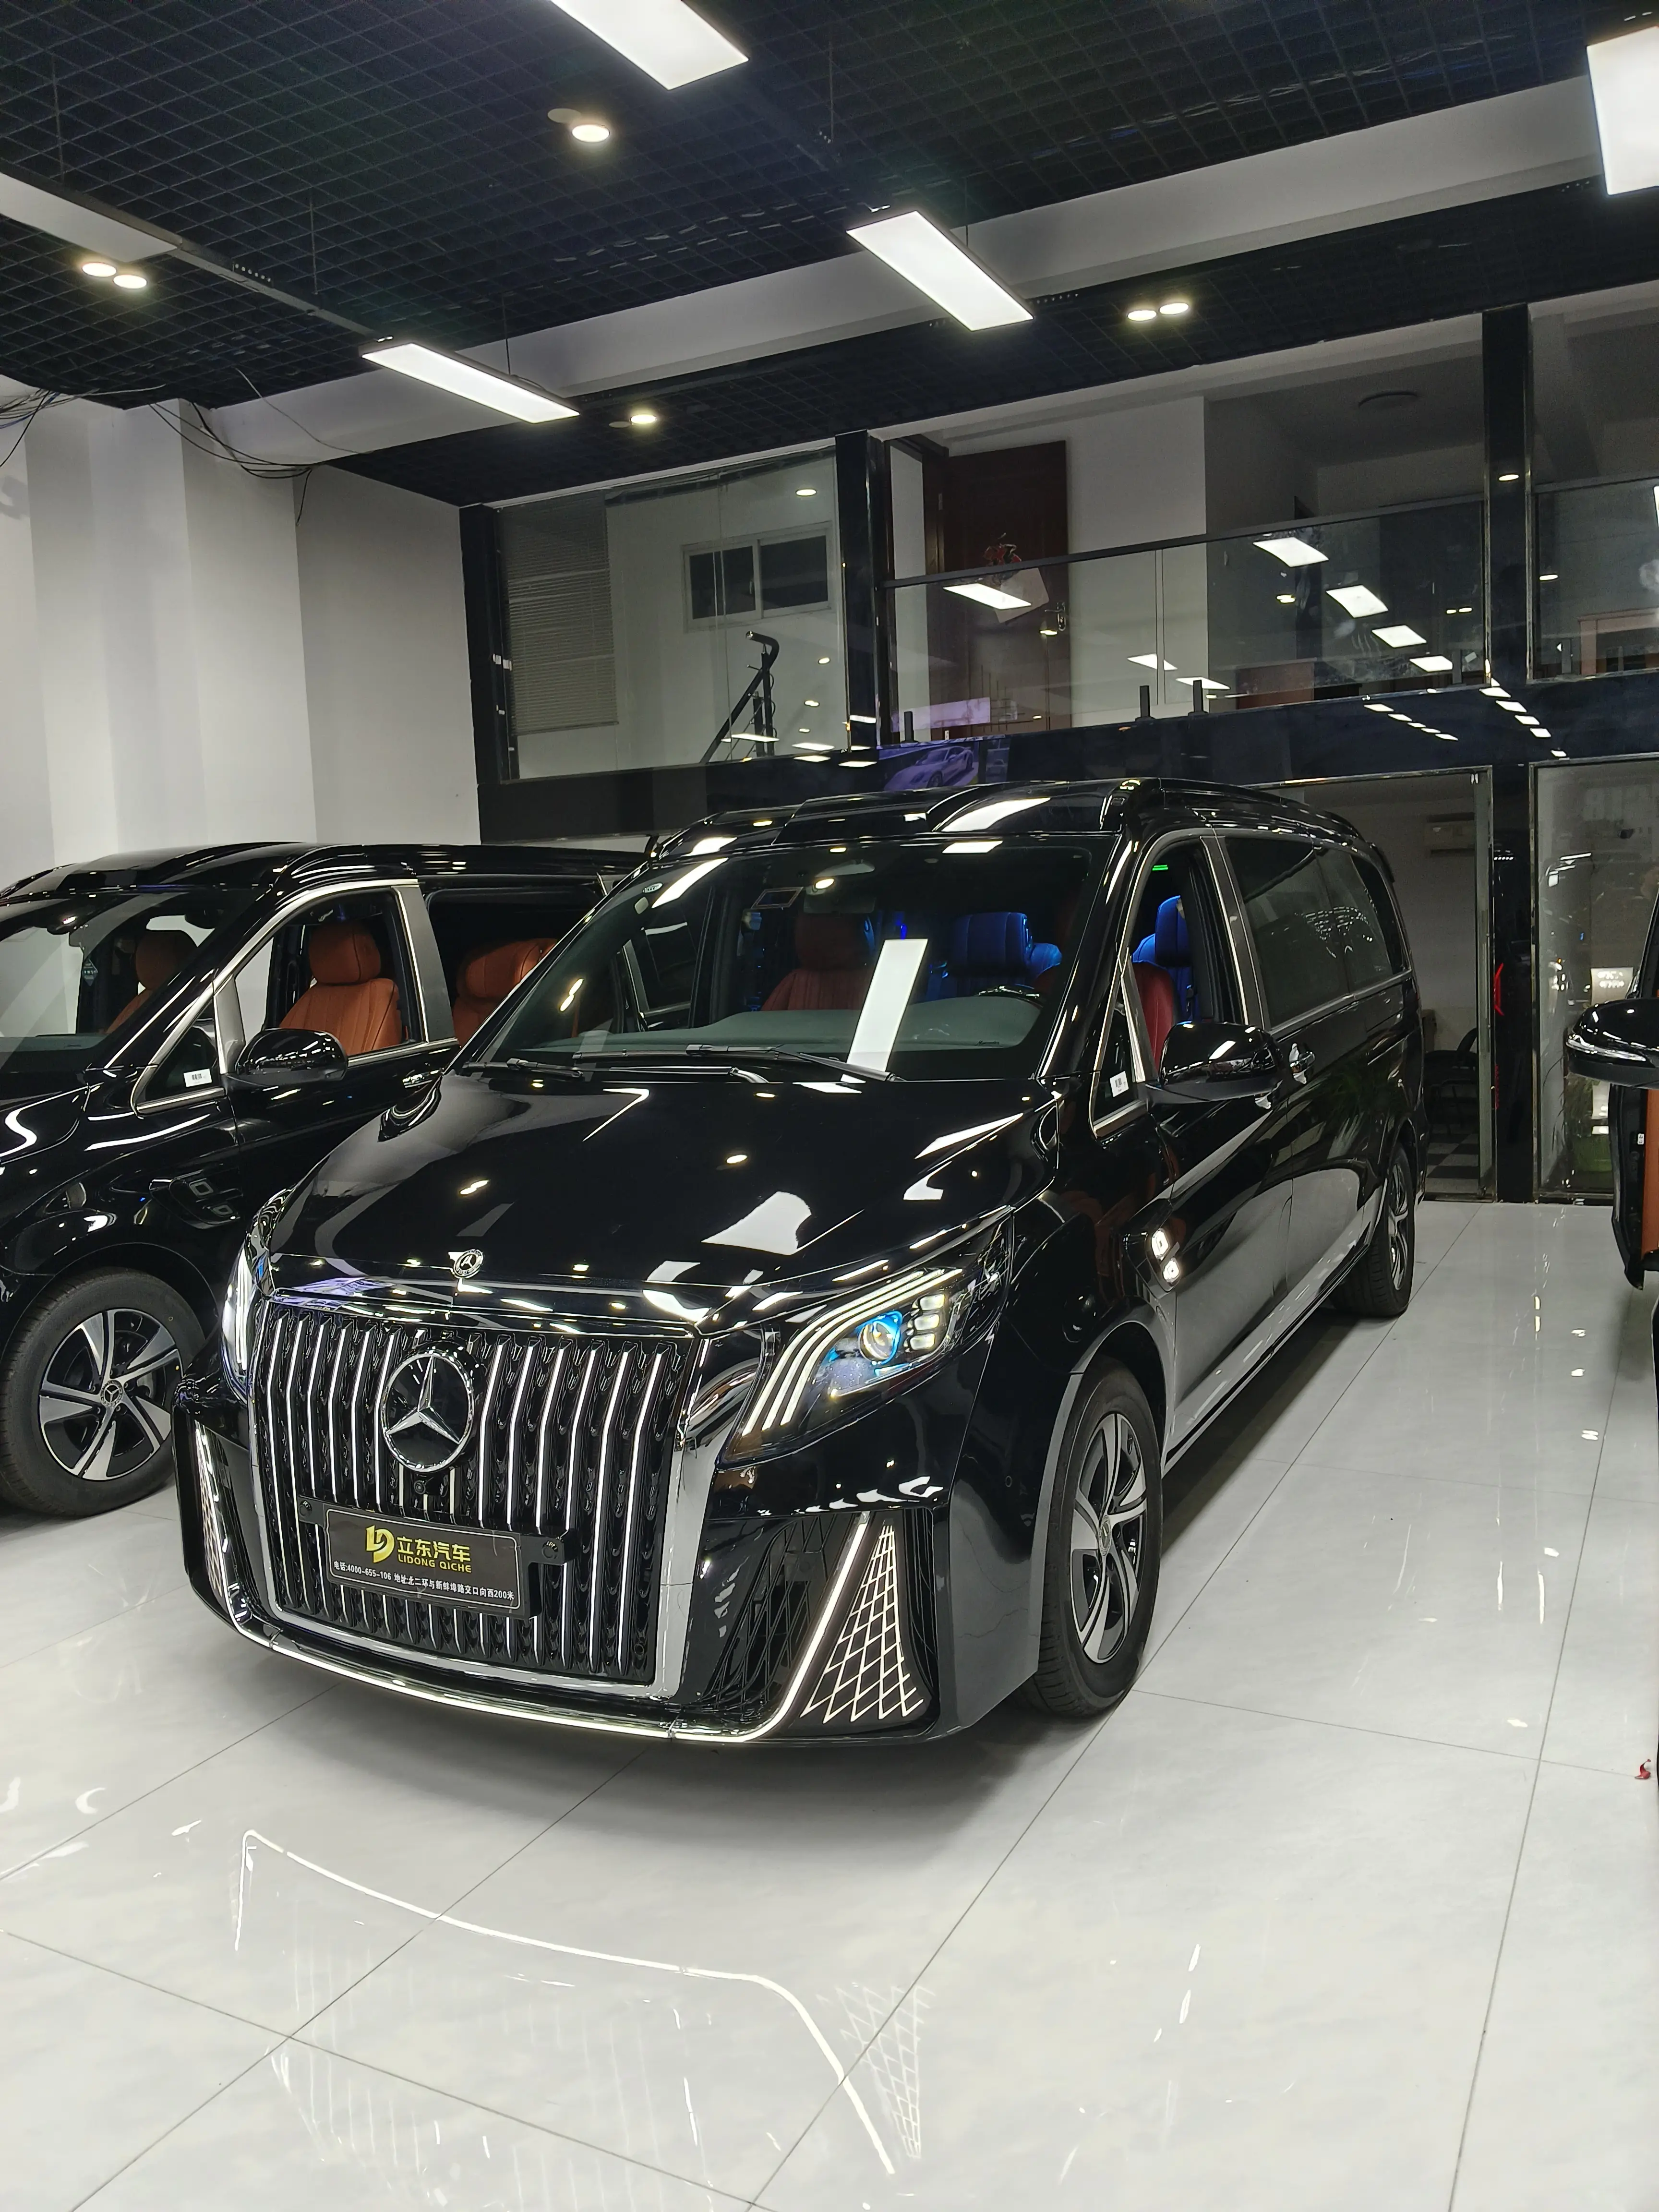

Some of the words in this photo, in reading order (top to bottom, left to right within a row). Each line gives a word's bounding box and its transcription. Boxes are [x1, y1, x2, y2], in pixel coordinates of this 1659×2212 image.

[397, 1537, 471, 1563] 立东汽车
[398, 1554, 435, 1568] LIDONG
[440, 1562, 472, 1573] QICHE
